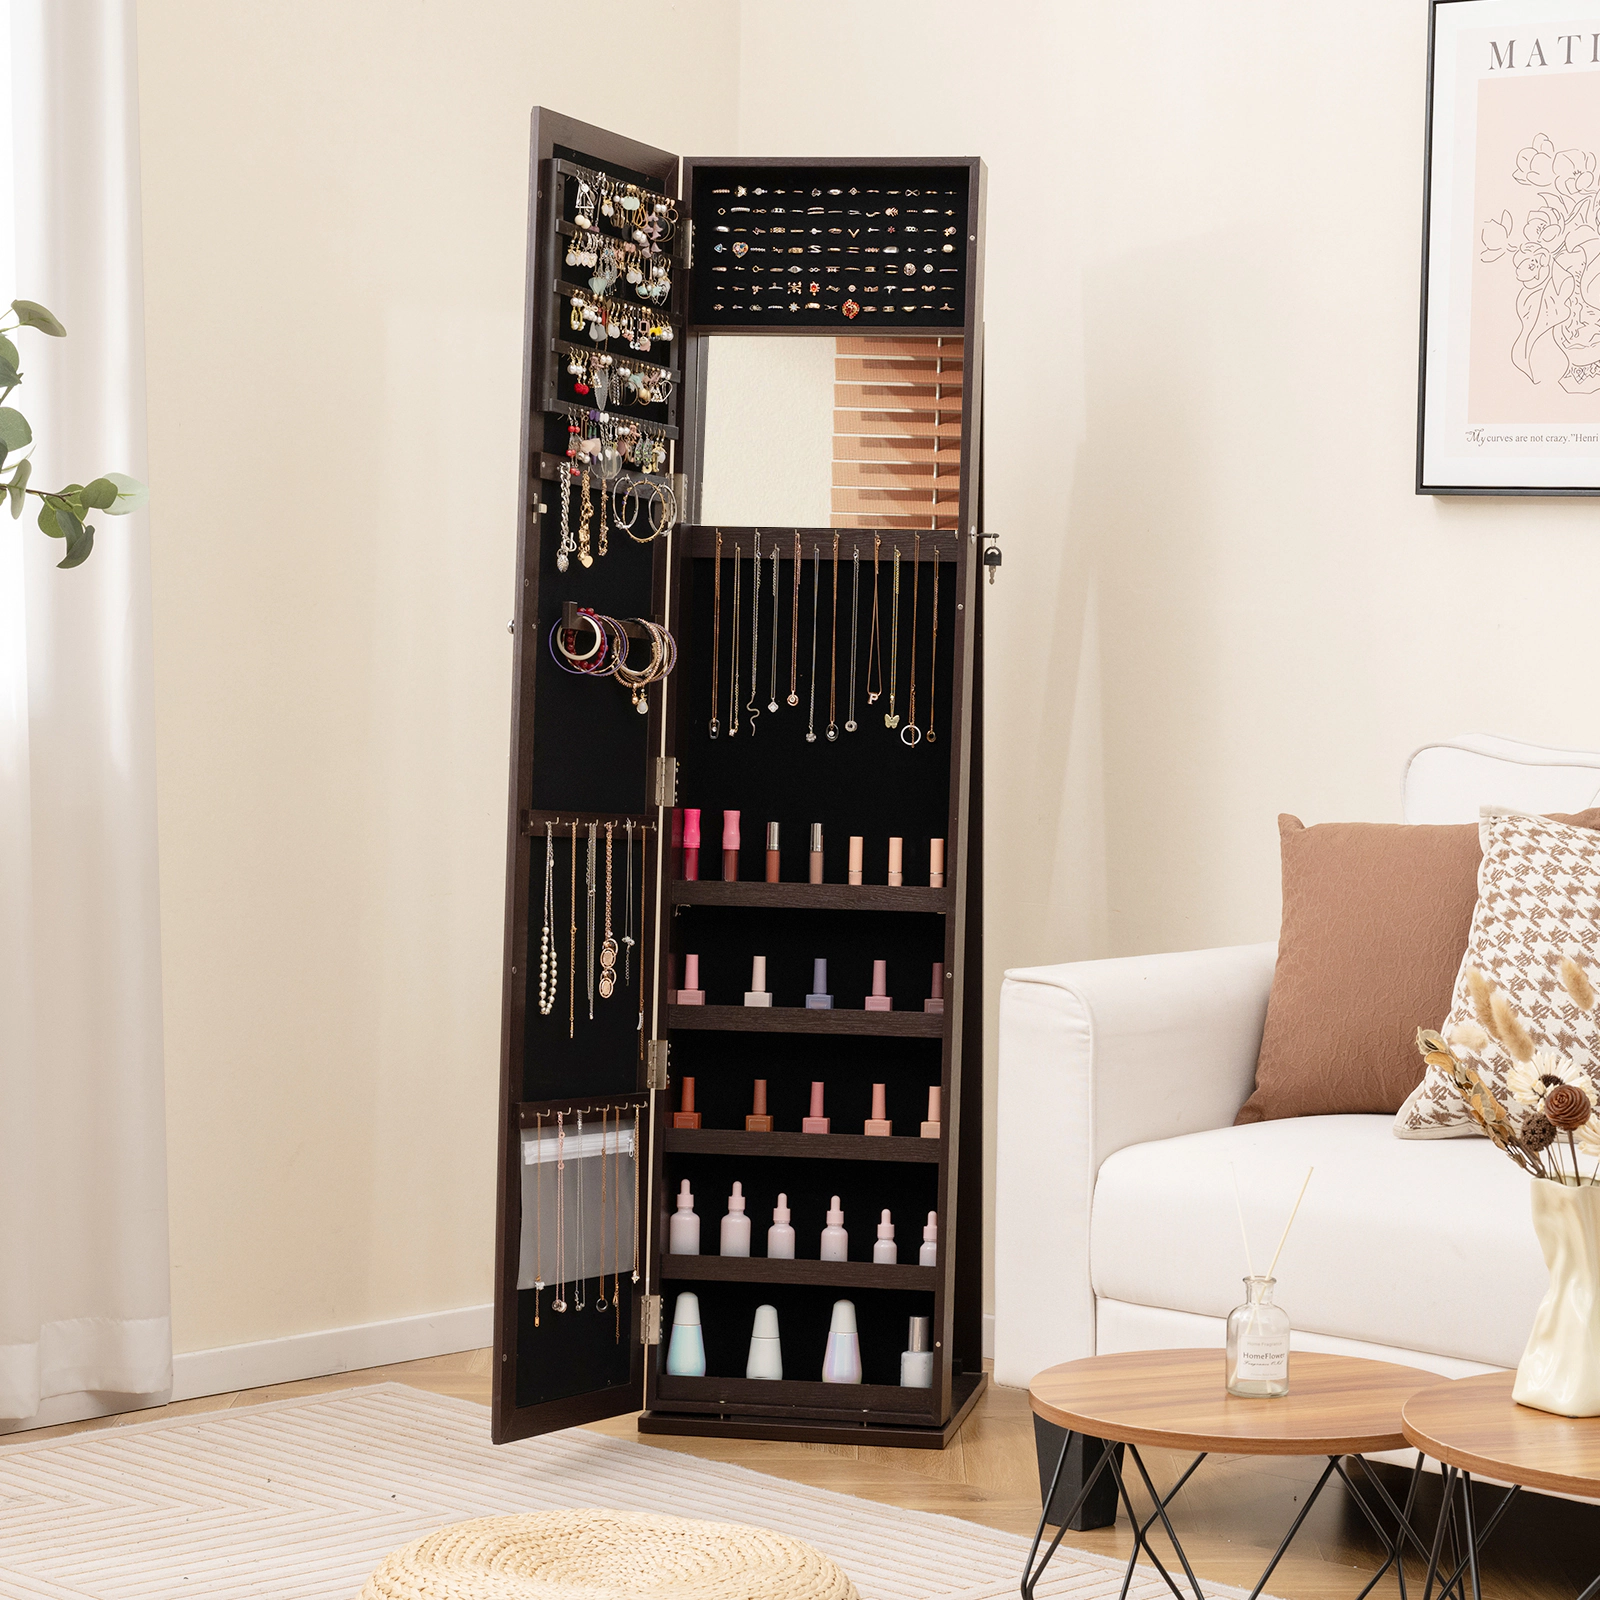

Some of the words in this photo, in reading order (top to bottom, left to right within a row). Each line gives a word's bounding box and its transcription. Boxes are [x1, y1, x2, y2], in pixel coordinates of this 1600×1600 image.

[1465, 428, 1485, 447] My
[1486, 434, 1514, 443] curves
[1515, 434, 1528, 443] are
[1530, 434, 1543, 443] not
